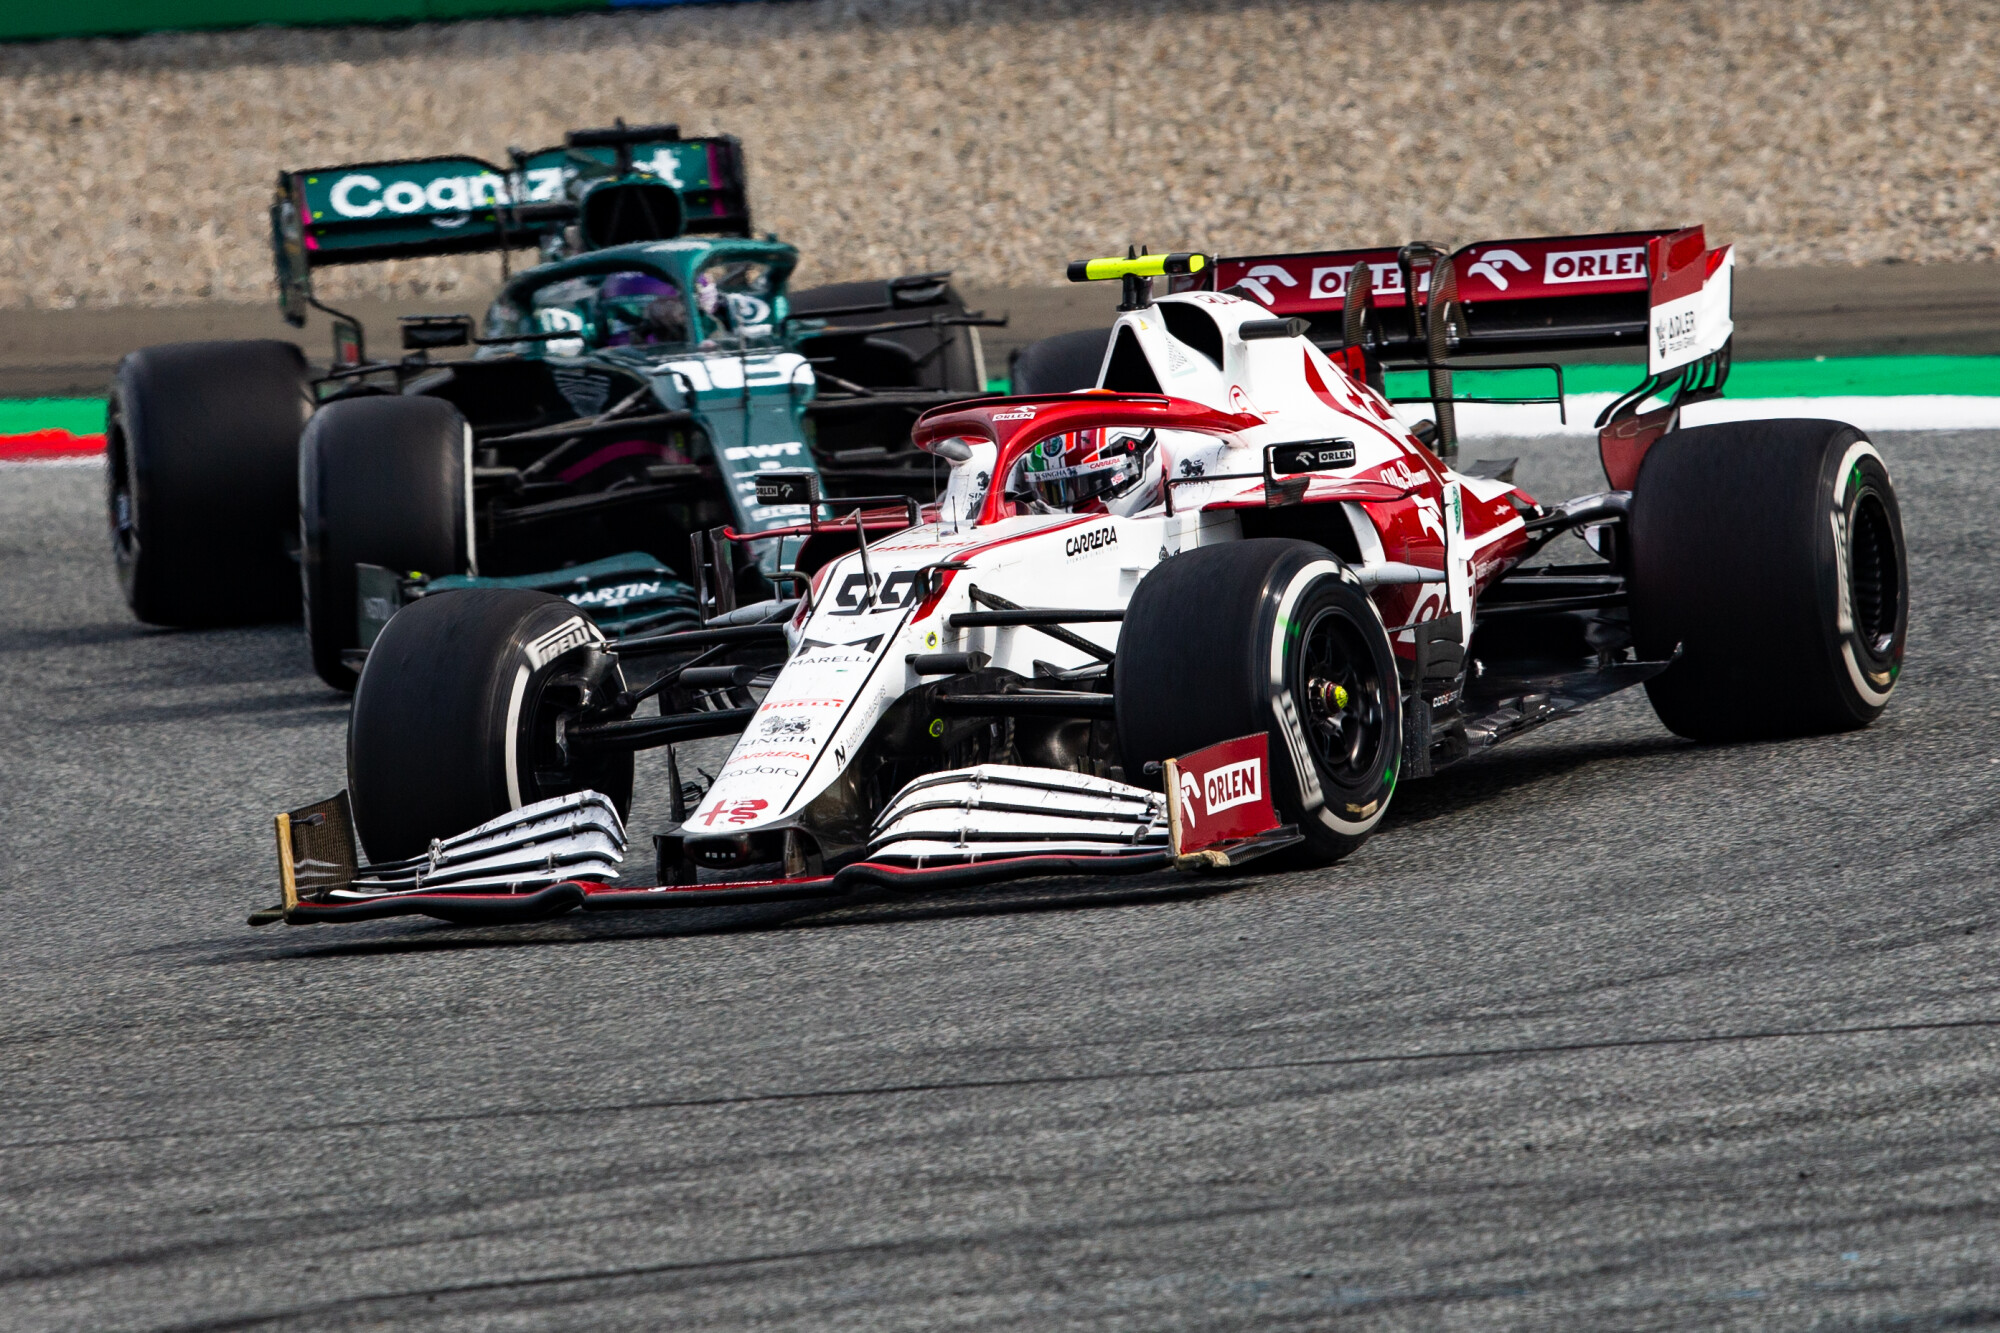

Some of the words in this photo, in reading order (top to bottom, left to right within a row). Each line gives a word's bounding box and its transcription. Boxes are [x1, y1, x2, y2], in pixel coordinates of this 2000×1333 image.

[1320, 449, 1353, 461] ORLEN
[1089, 458, 1120, 470] CARRERA
[1041, 469, 1067, 479] SINGHA
[1065, 525, 1118, 557] CARRERA
[828, 569, 918, 616] 99
[525, 615, 591, 672] PIRELLI
[788, 655, 872, 668] MARELLI
[760, 697, 845, 712] PIRELLI
[737, 735, 817, 747] SINGHA
[727, 750, 810, 765] CARRERA
[1208, 765, 1256, 807] ORLEN
